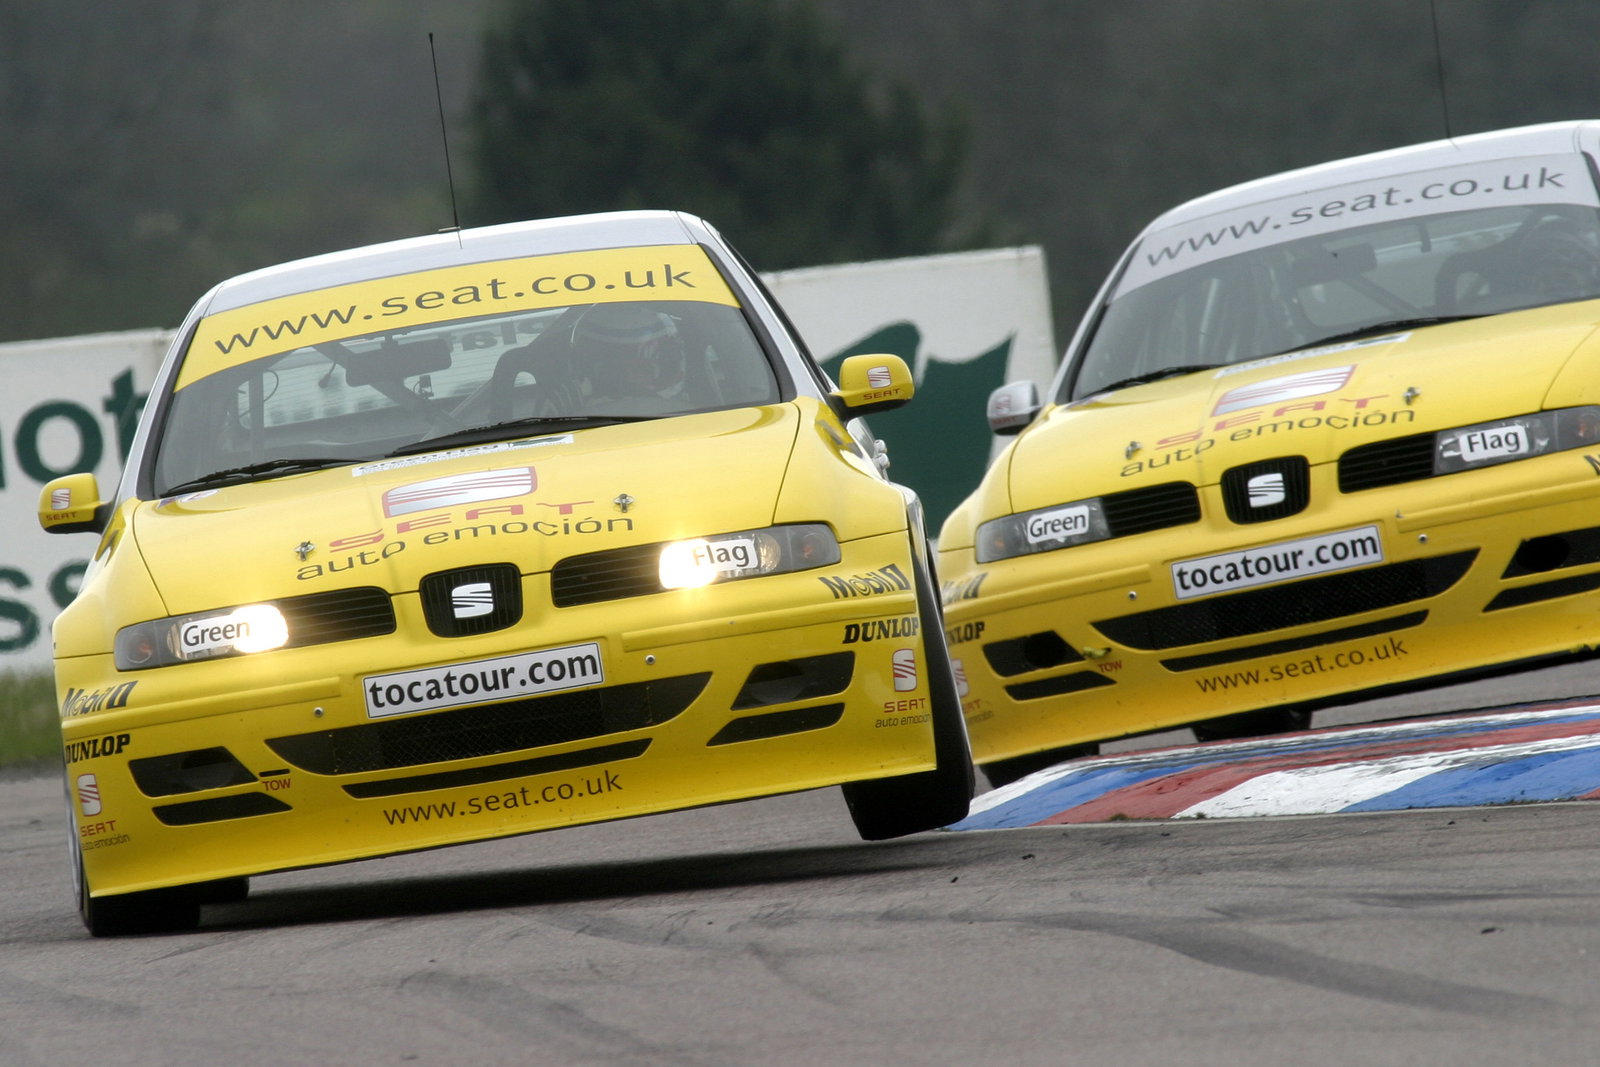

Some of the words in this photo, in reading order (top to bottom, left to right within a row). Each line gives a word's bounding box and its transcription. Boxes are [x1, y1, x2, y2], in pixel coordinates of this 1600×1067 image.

[1146, 166, 1565, 268] www.seat.co.uk
[214, 263, 696, 355] www.seat.co.uk
[863, 388, 901, 400] SEAT
[1154, 394, 1389, 450] SEAT
[1119, 438, 1216, 478] auto
[1229, 409, 1416, 442] emoción
[1467, 428, 1521, 456] Flag
[328, 501, 595, 553] SEAT
[1029, 512, 1087, 539] Green
[296, 541, 406, 581] auto
[423, 516, 634, 546] emoción
[692, 544, 750, 568] Flag
[1176, 533, 1379, 590] tocatour.com
[182, 619, 250, 648] Green
[842, 616, 919, 645] DUNLOP
[368, 652, 599, 709] tocatour.com
[1097, 660, 1122, 673] TOW
[1195, 636, 1408, 695] www.seat.co.uk
[884, 698, 926, 713] SEAT
[875, 715, 899, 729] auto
[65, 733, 131, 765] DUNLOP
[262, 778, 292, 792] TOW
[382, 770, 623, 826] www.seat.co.uk
[80, 820, 117, 837] SEAT
